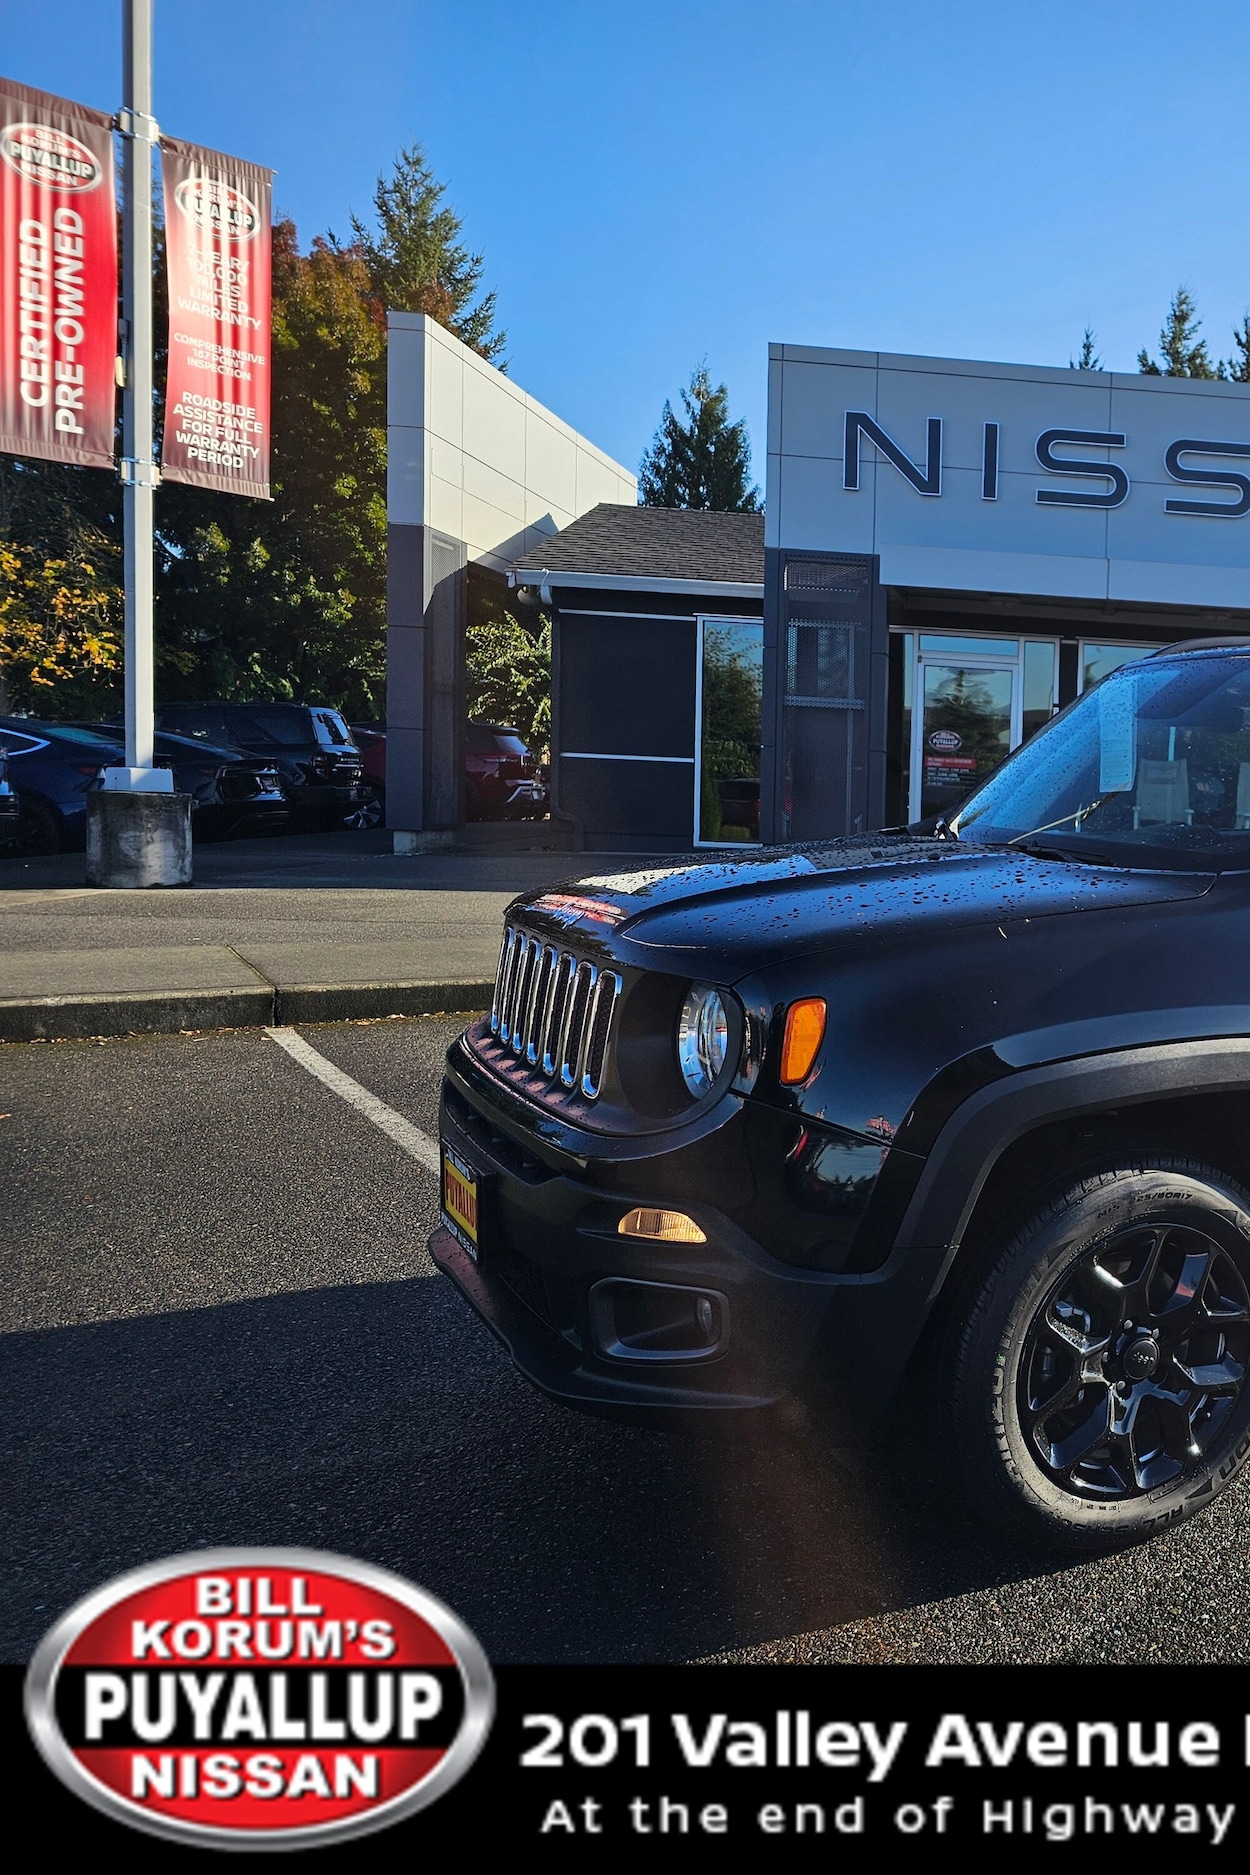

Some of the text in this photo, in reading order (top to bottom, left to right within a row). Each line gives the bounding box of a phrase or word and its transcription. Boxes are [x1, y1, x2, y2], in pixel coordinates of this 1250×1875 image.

[10, 141, 95, 179] PUYALLUP
[21, 162, 79, 187] NISSAN
[189, 284, 249, 314] LIMITED
[196, 274, 241, 298] MILES
[19, 218, 49, 407] CERTIFIED
[54, 207, 85, 435] PRE-OWNED
[176, 295, 263, 331] WARRANTY
[174, 332, 266, 366] COMPREHENSIVE
[192, 348, 246, 370] 167 POINT
[186, 356, 252, 381] INSPECTION
[173, 403, 264, 434] ASSISTANCE
[182, 391, 256, 419] ROADSIDE
[175, 430, 260, 459] WARRANTY
[182, 418, 252, 445] FOR FULL
[187, 446, 245, 469] PERIOD
